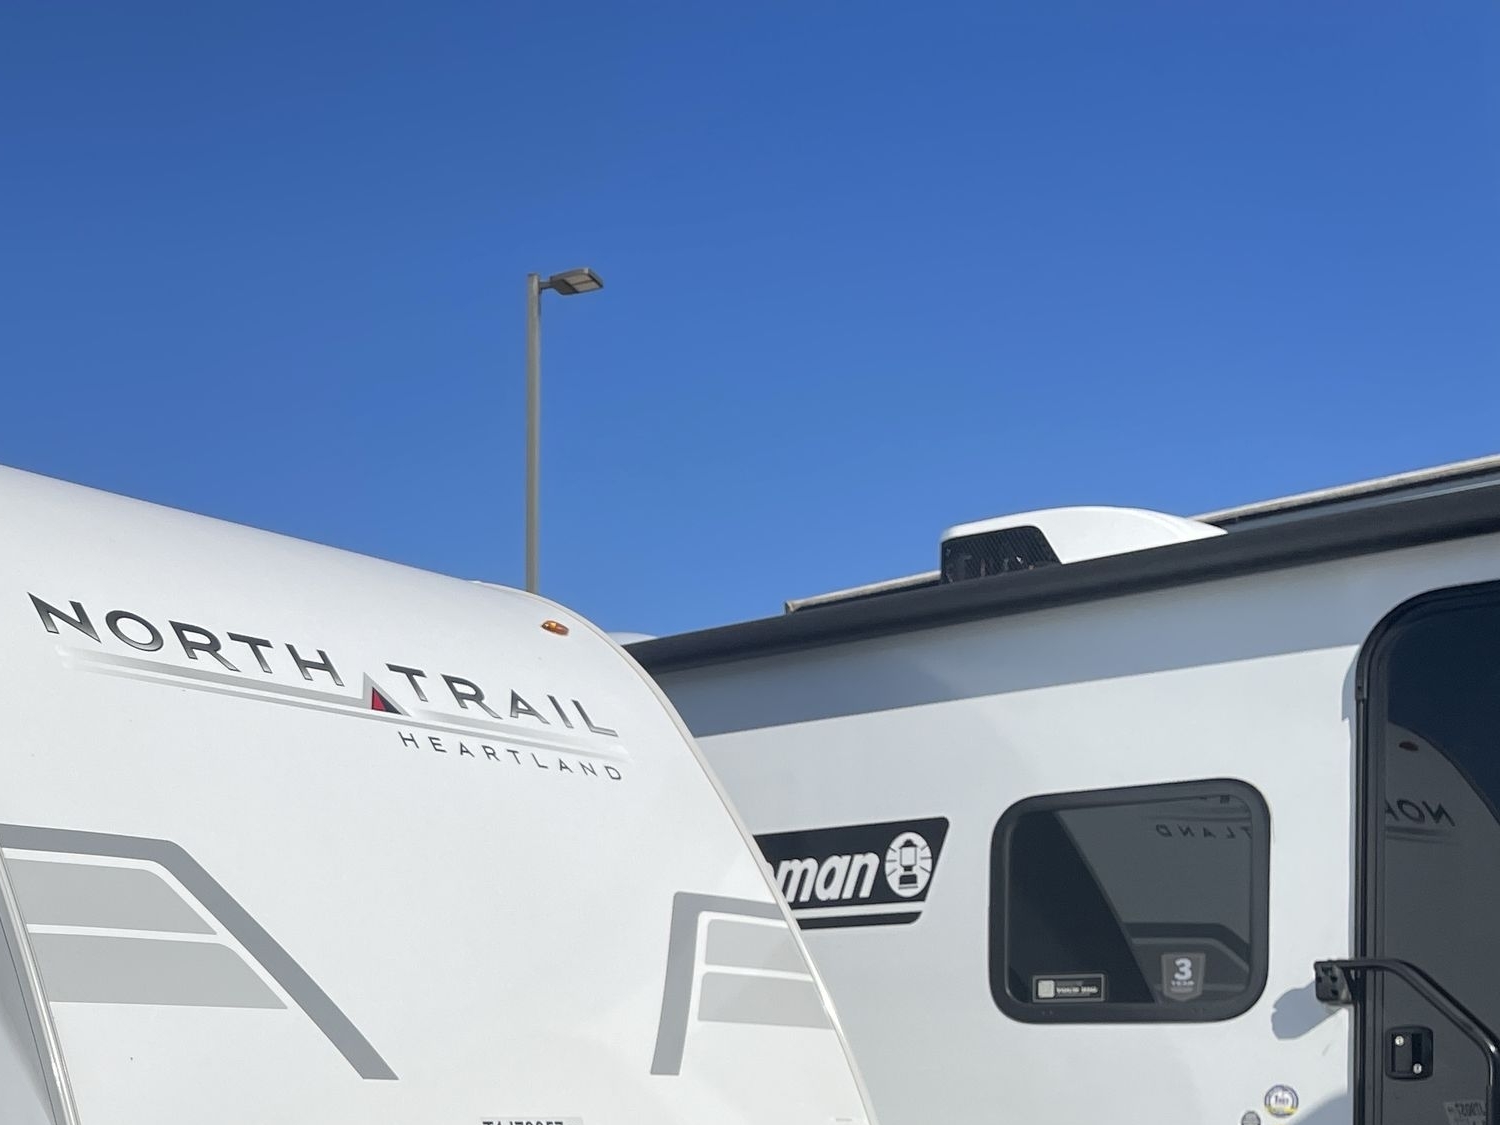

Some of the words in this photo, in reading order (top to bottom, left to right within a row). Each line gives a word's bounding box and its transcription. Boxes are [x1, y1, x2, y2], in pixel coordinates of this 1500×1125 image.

[27, 591, 346, 687] NORTH
[386, 662, 618, 737] TRAIL
[400, 730, 622, 782] HEARTLAND
[767, 852, 880, 903] man
[1175, 958, 1192, 980] 3
